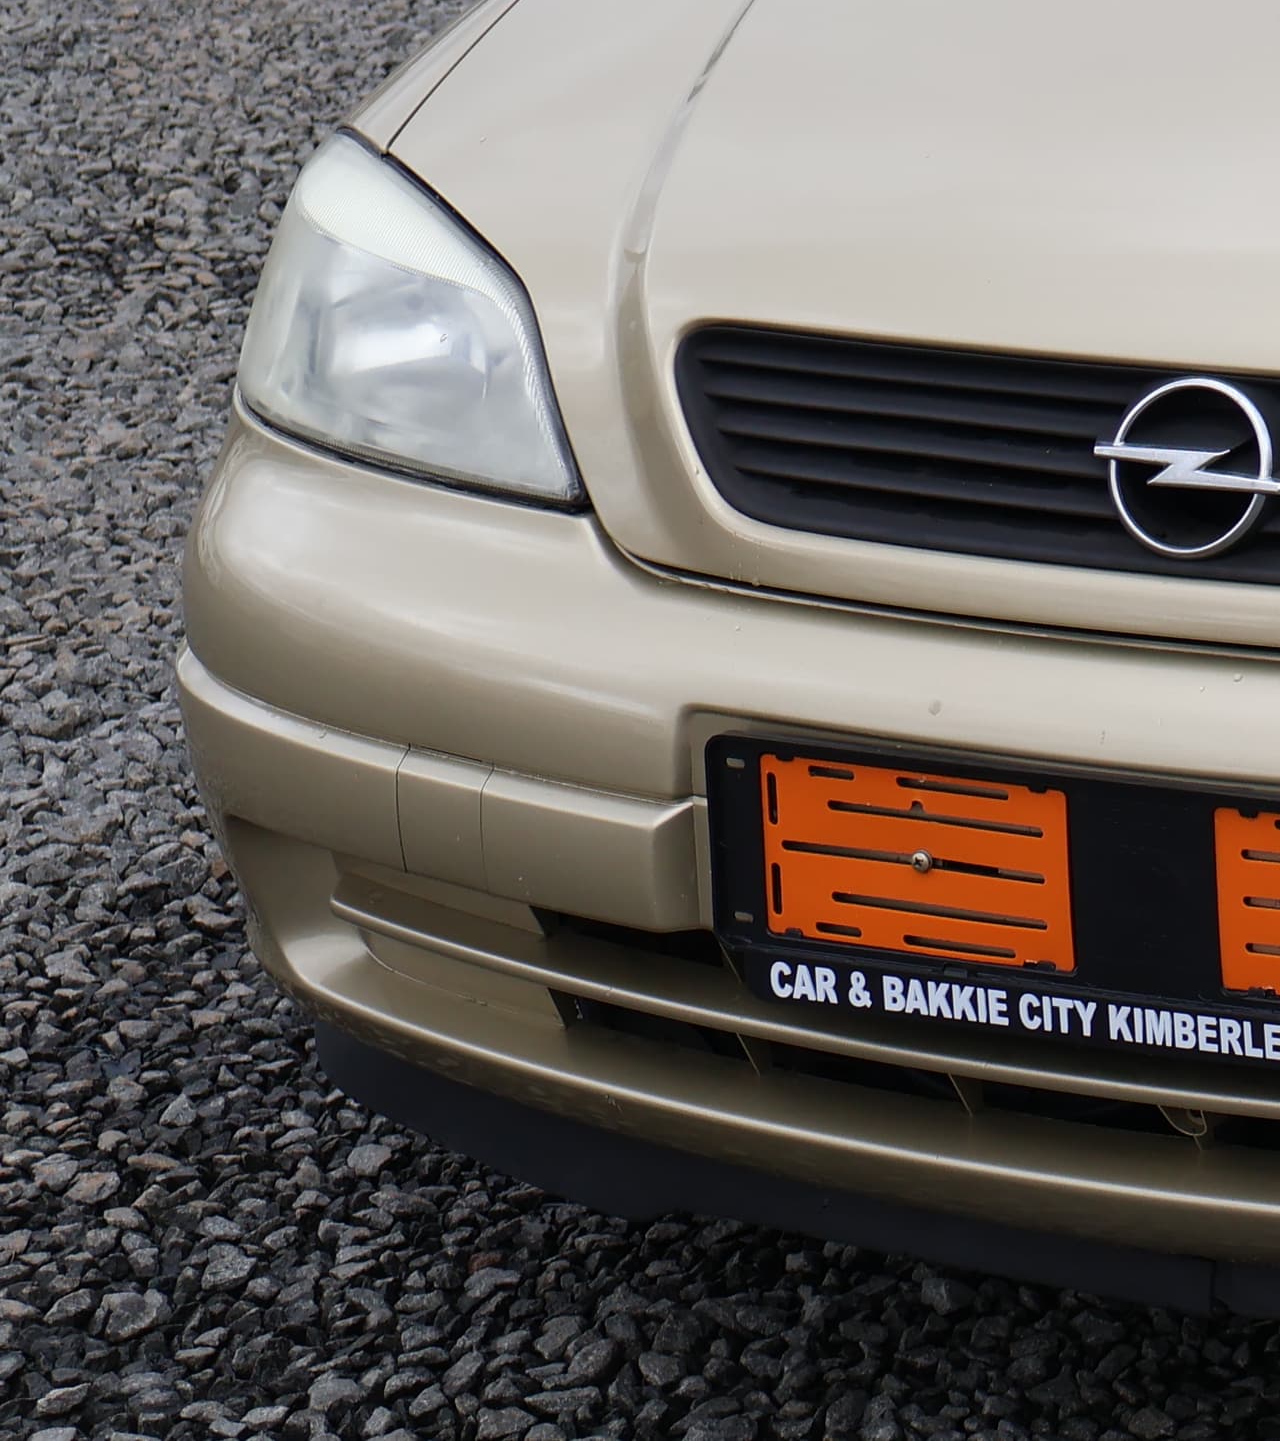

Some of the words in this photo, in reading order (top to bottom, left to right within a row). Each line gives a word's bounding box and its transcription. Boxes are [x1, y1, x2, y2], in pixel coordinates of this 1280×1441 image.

[769, 961, 838, 1004] CAR
[848, 971, 873, 1008] &
[882, 975, 1009, 1026] BAKKIE
[1019, 993, 1097, 1037] CITY
